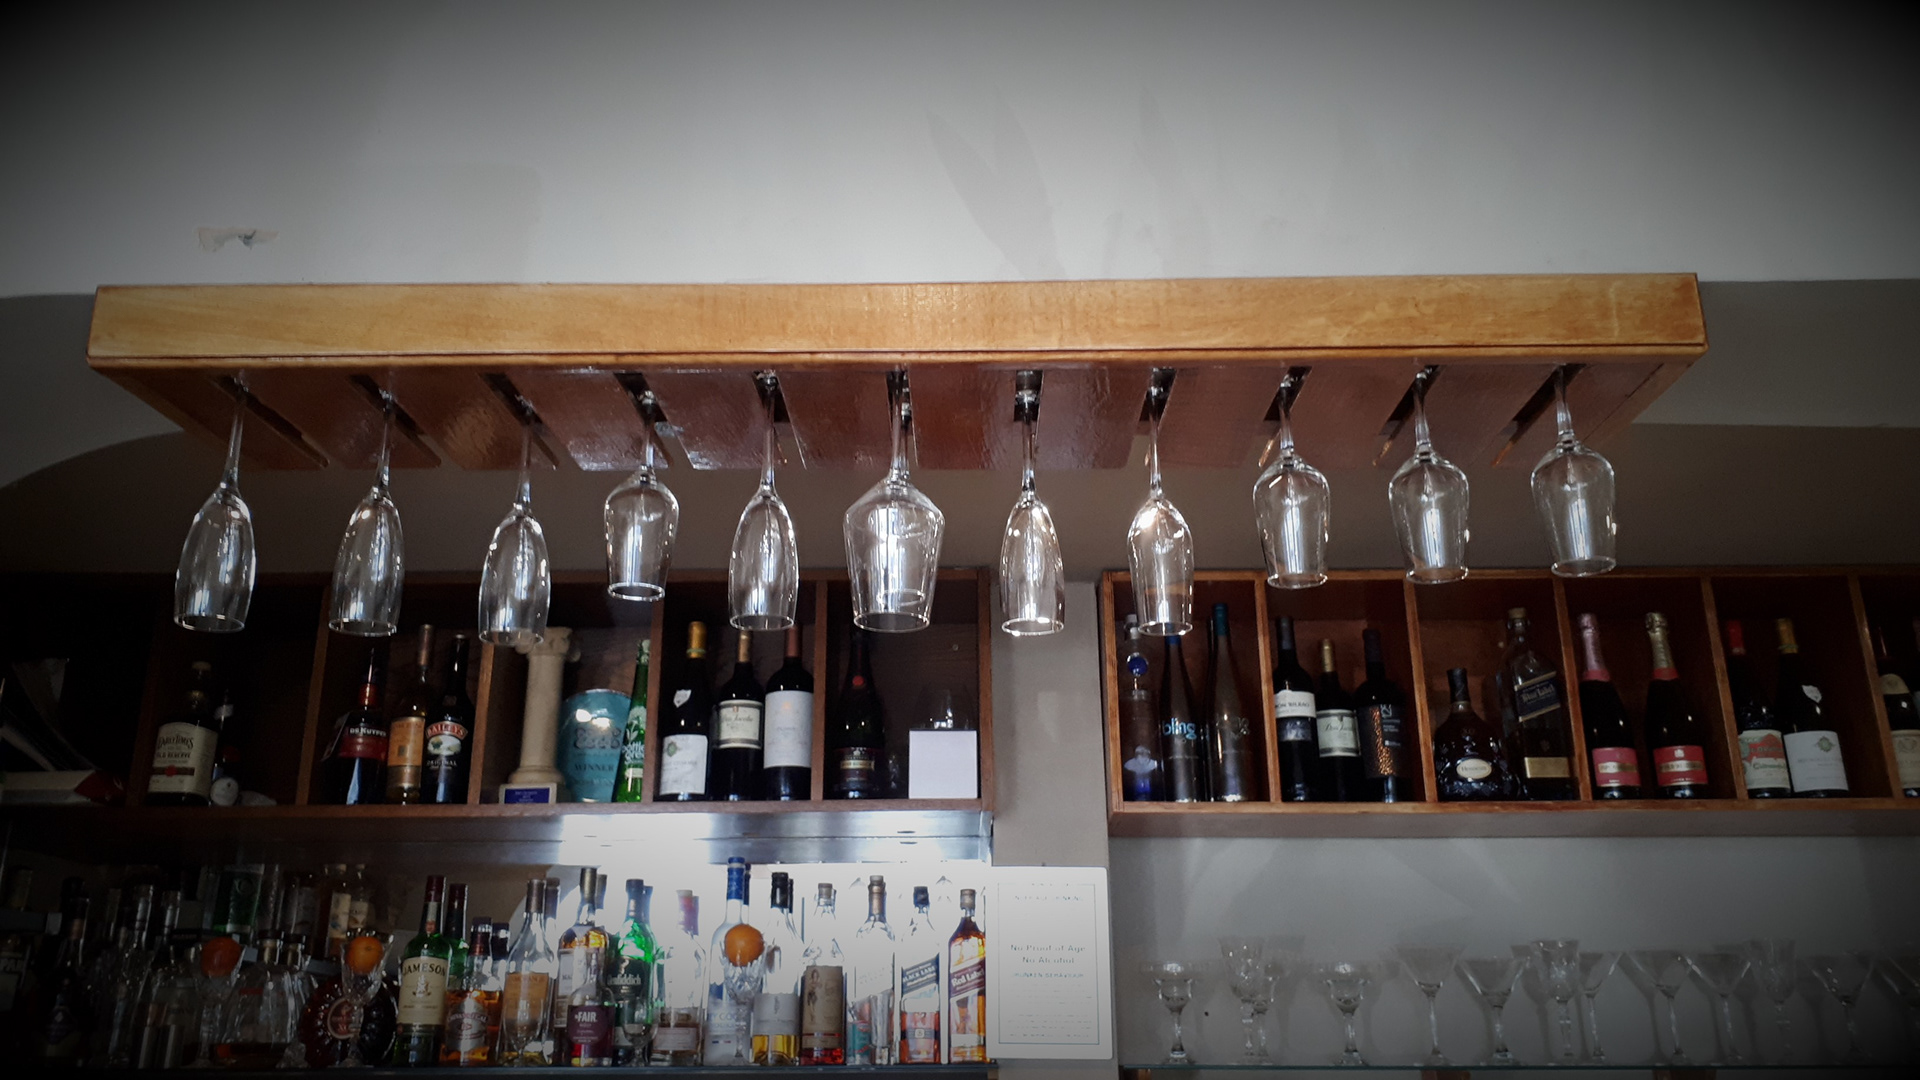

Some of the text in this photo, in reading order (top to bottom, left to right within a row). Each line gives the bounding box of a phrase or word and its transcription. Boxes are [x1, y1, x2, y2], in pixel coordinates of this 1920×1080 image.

[427, 721, 464, 737] BAILEYS
[1162, 717, 1197, 740] bling
[402, 962, 446, 977] JAMESON
[951, 974, 966, 987] Red
